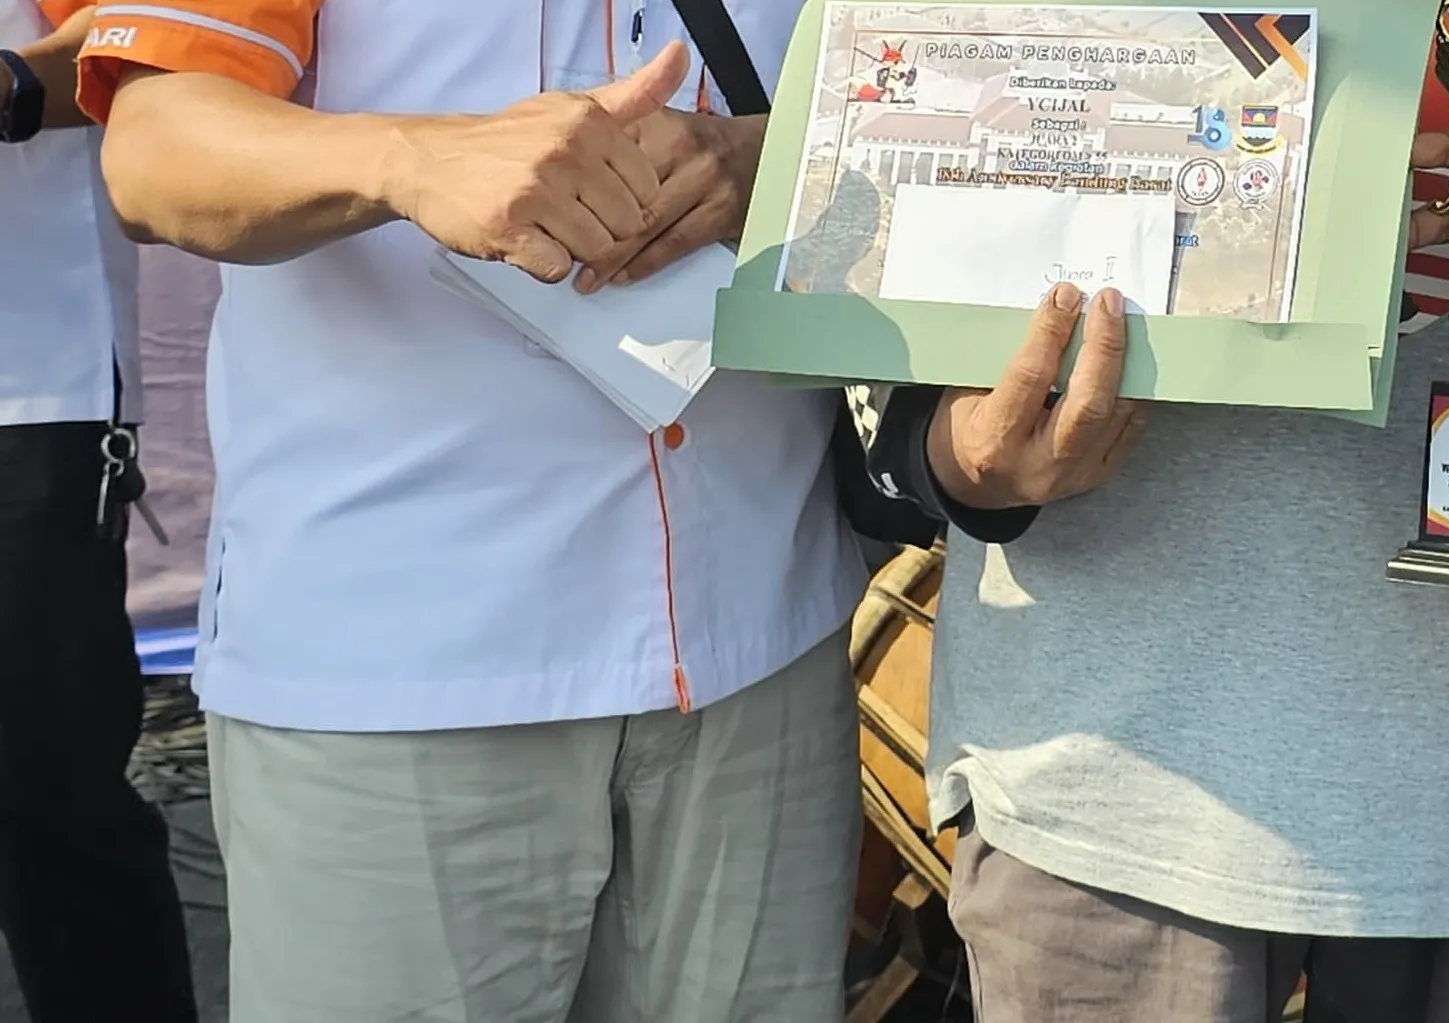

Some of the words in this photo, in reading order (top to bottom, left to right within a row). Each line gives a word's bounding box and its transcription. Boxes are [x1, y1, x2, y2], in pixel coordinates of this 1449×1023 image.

[925, 42, 1012, 60] PIAGAM
[1021, 44, 1197, 65] PENGHARGAAN
[1008, 76, 1067, 90] Diberikan
